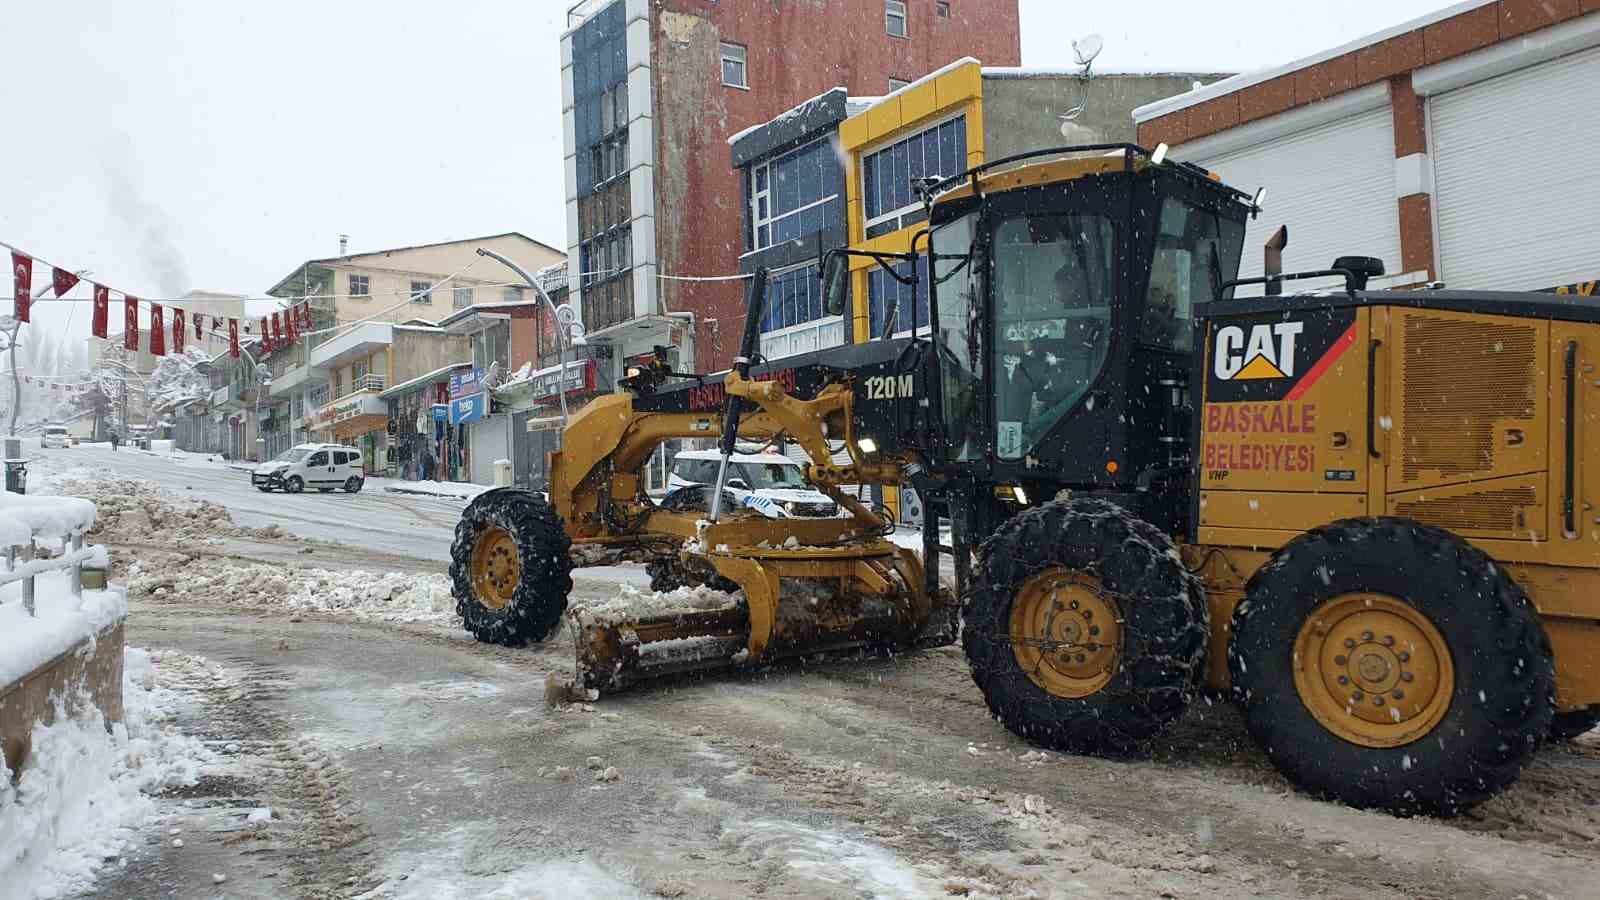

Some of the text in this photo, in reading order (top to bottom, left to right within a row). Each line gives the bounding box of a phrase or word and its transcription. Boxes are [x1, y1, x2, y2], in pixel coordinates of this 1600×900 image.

[1214, 321, 1304, 381] CAT
[1207, 404, 1316, 438] BAŞKALE
[1205, 444, 1314, 471] BELEDİYESİ
[1208, 471, 1229, 480] VHP
